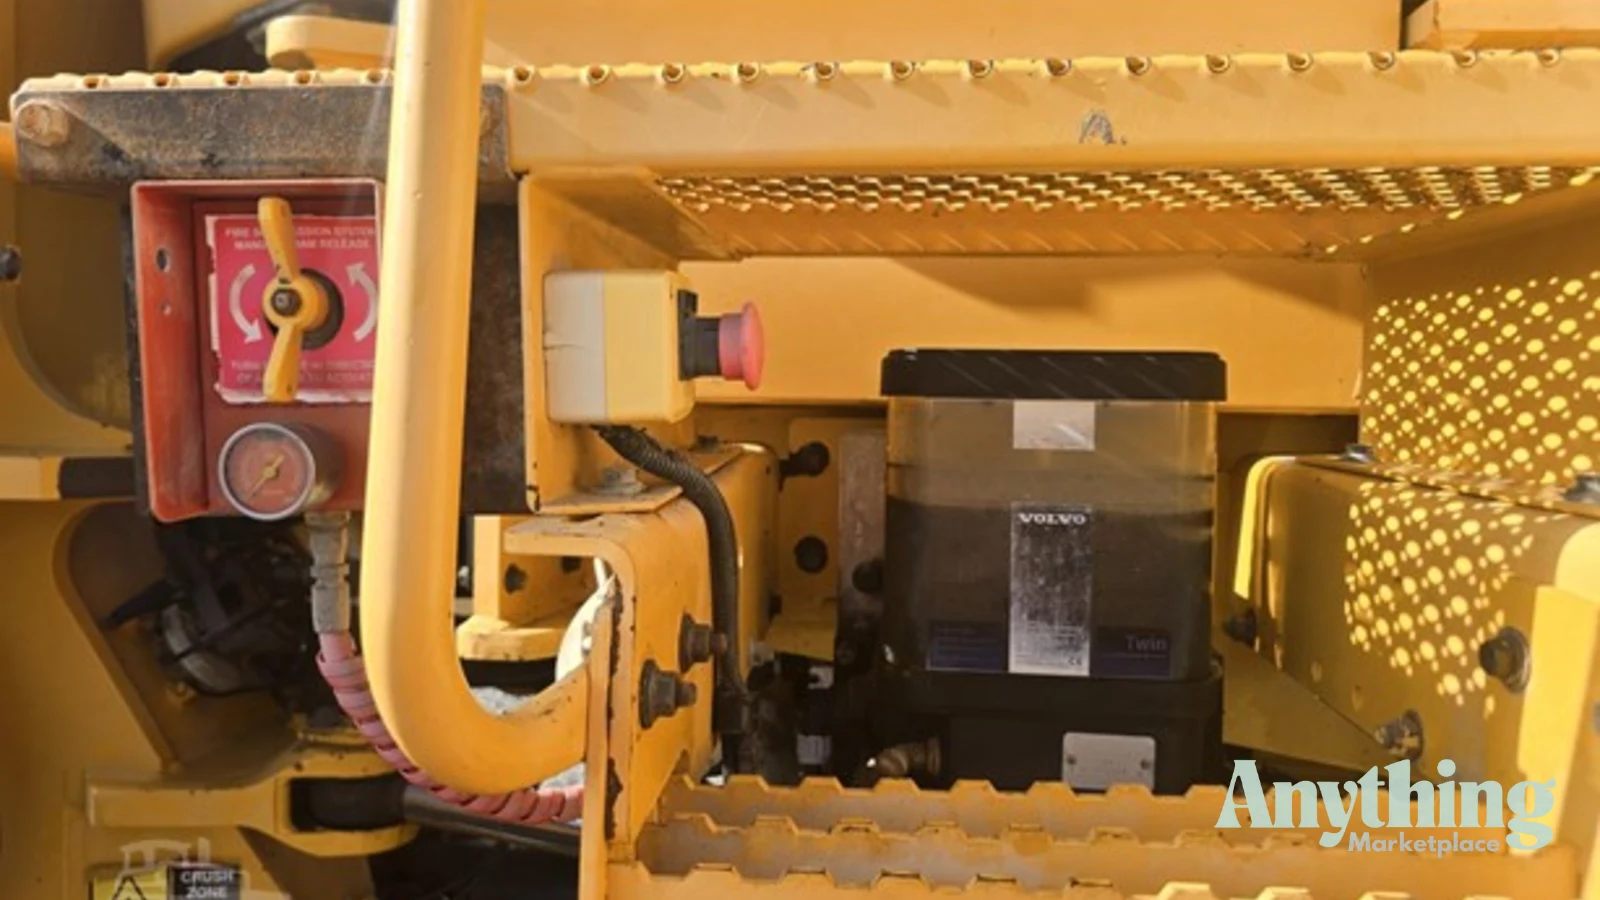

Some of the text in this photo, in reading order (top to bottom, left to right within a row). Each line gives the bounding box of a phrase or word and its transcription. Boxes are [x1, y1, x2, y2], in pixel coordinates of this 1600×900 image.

[1018, 512, 1087, 525] VOLVO
[1125, 634, 1167, 651] Twin
[180, 869, 235, 884] CRUSH
[185, 885, 229, 900] ZONE
